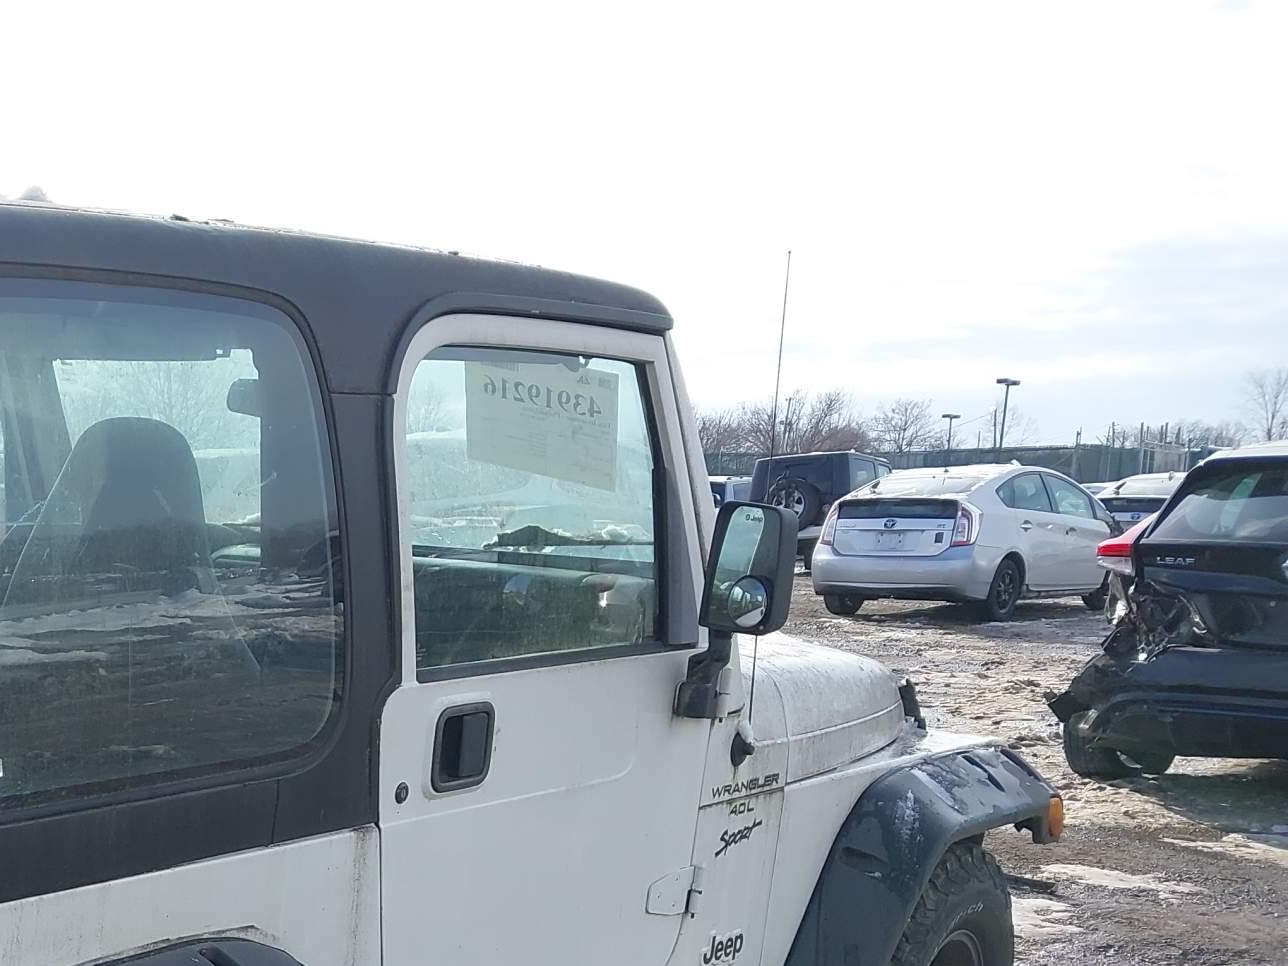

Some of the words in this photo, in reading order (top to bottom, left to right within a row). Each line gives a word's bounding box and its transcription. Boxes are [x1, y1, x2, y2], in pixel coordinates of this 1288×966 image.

[1156, 556, 1196, 565] LEAF
[712, 772, 780, 799] WRANGLER
[714, 818, 763, 858] Sport
[702, 933, 744, 965] Jeep
